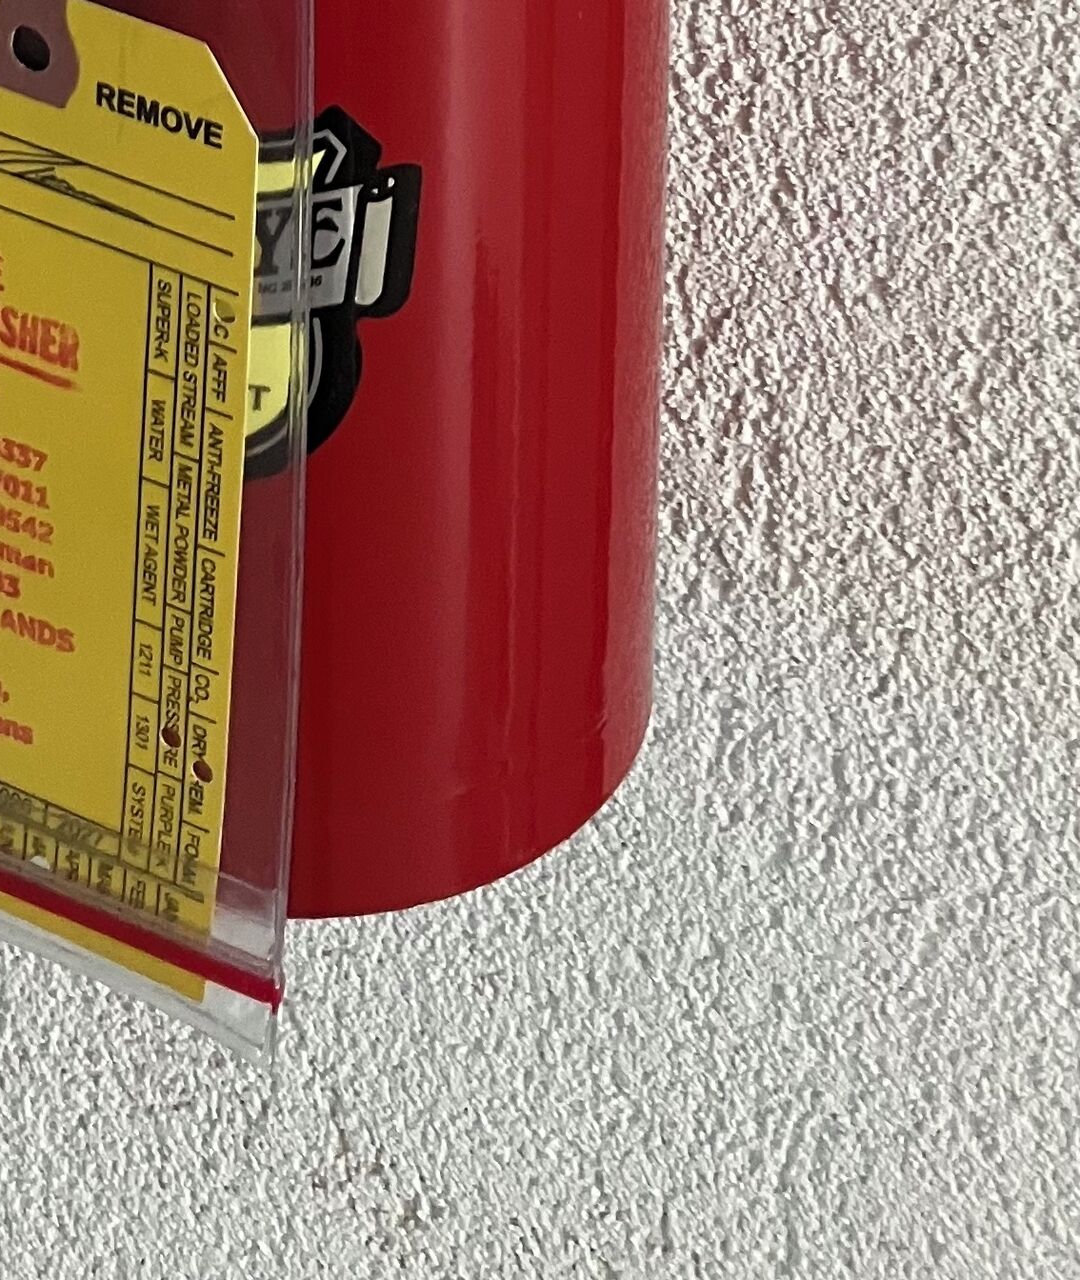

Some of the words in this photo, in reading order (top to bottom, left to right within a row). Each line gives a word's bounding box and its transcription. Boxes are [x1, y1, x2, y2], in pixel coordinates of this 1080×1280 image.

[95, 81, 224, 150] REMOVE
[154, 279, 172, 363] SUPER-K
[184, 291, 202, 368] LOADED
[180, 370, 198, 449] STREAM
[211, 352, 228, 403] AFFF
[148, 399, 166, 462] WATER
[175, 462, 192, 520] METAL
[202, 422, 224, 542] ANTI-FREEZE
[144, 504, 160, 545] WET
[141, 544, 158, 607] AGENT
[171, 523, 189, 604] POWDER
[170, 613, 185, 667] PUMP
[196, 557, 217, 661] CARTRIDGE
[138, 642, 153, 678] 1211
[135, 714, 150, 751] 1301
[163, 674, 182, 769] PRESSRE
[128, 781, 146, 856] SYSTE
[156, 783, 176, 853] PURPLE
